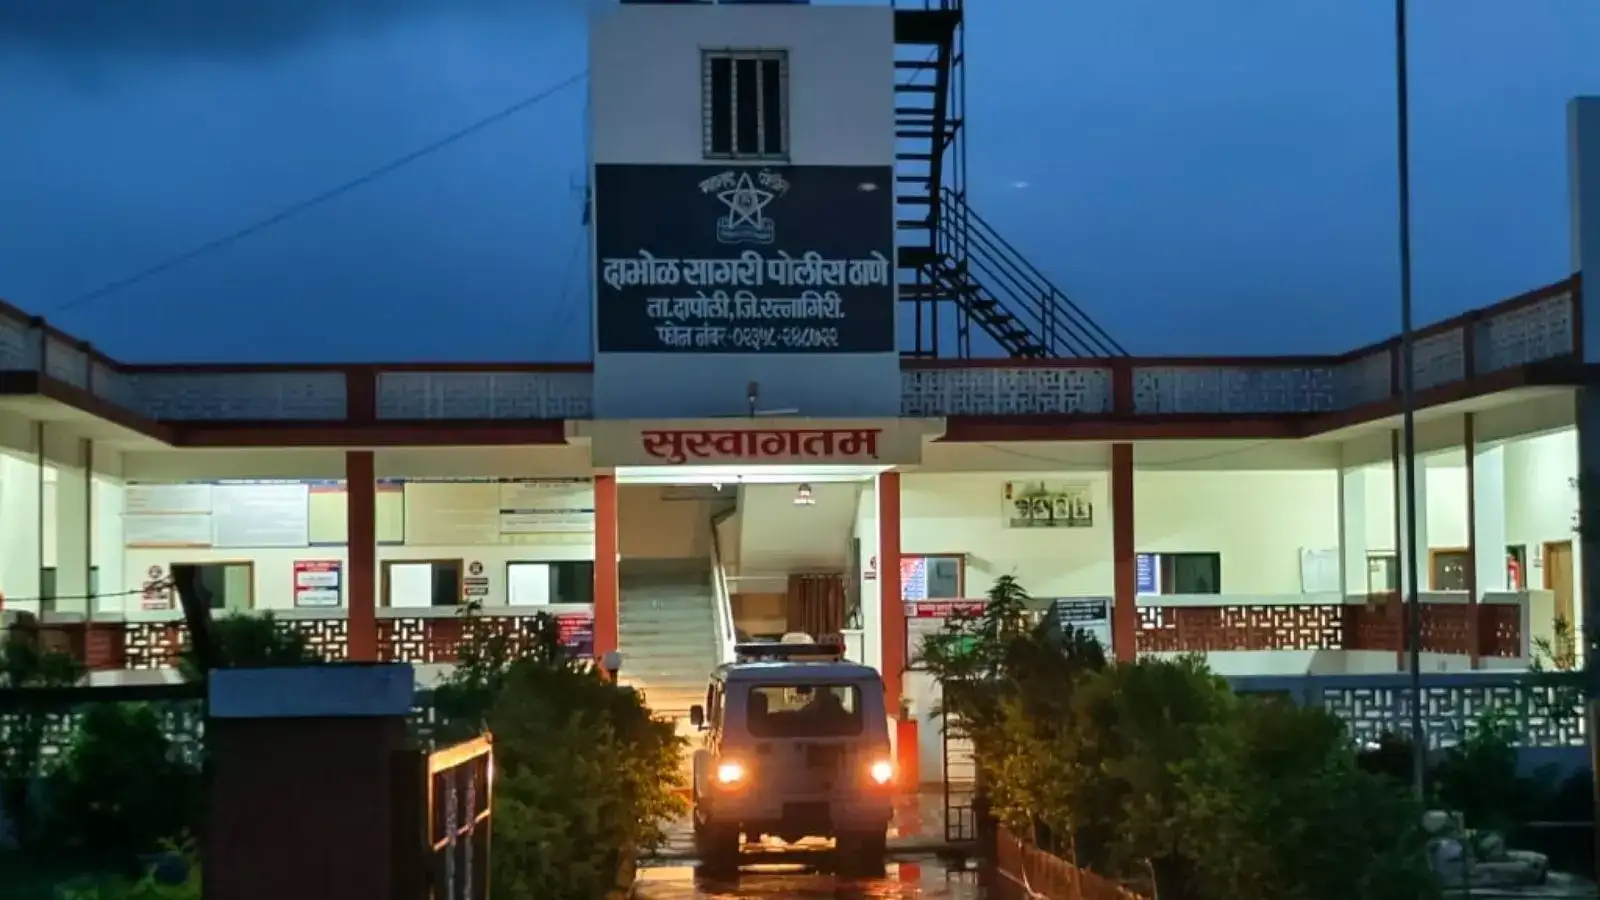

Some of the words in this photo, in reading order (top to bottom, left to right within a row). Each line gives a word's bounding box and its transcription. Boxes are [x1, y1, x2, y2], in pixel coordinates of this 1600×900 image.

[603, 250, 679, 290] दाभोळ
[682, 250, 764, 286] सागरी
[767, 250, 845, 286] पोलीस
[848, 250, 890, 286] ठाणे
[655, 322, 692, 347] फोन
[642, 429, 882, 463] सुस्वागतम्
